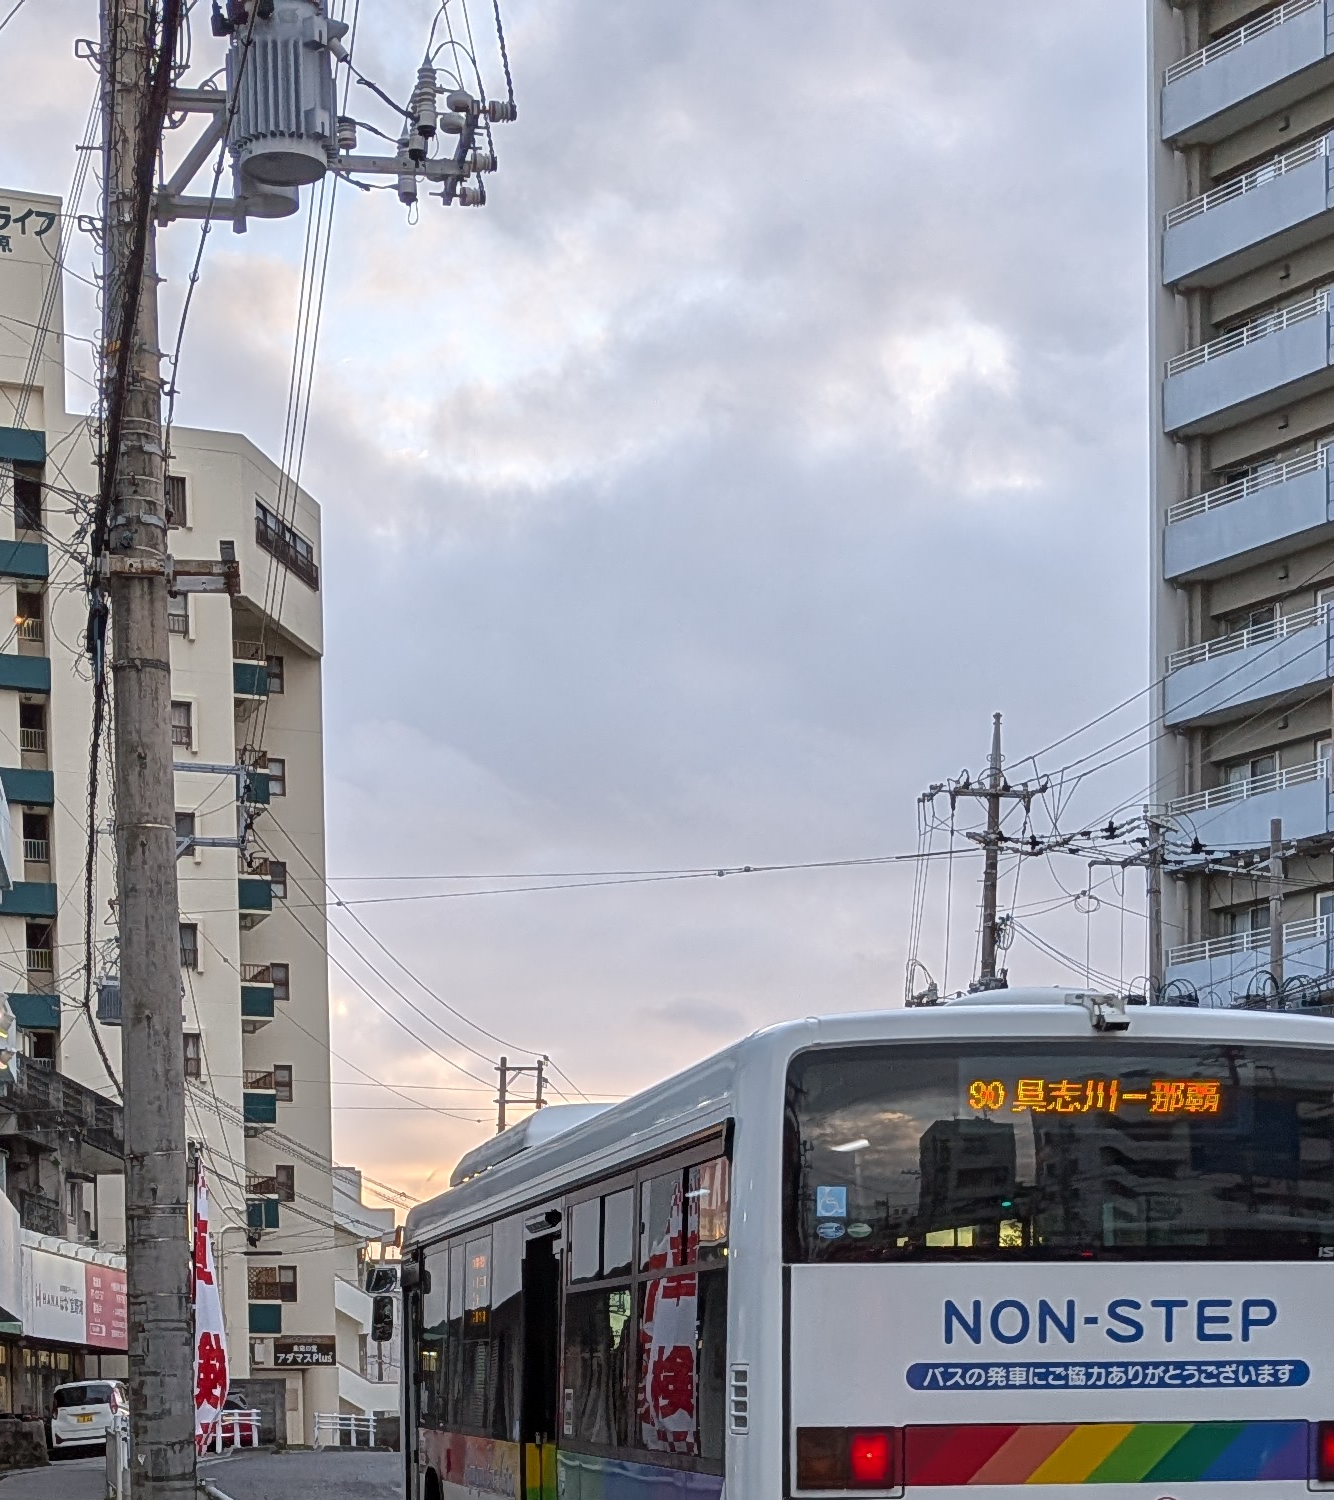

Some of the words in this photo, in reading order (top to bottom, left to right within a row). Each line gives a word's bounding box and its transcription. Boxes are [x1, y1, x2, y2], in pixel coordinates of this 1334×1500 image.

[969, 1080, 1005, 1110] 90
[943, 1298, 1278, 1345] NON-STEP
[923, 1363, 1295, 1388] バスの発車にご協力ありがとうございます
